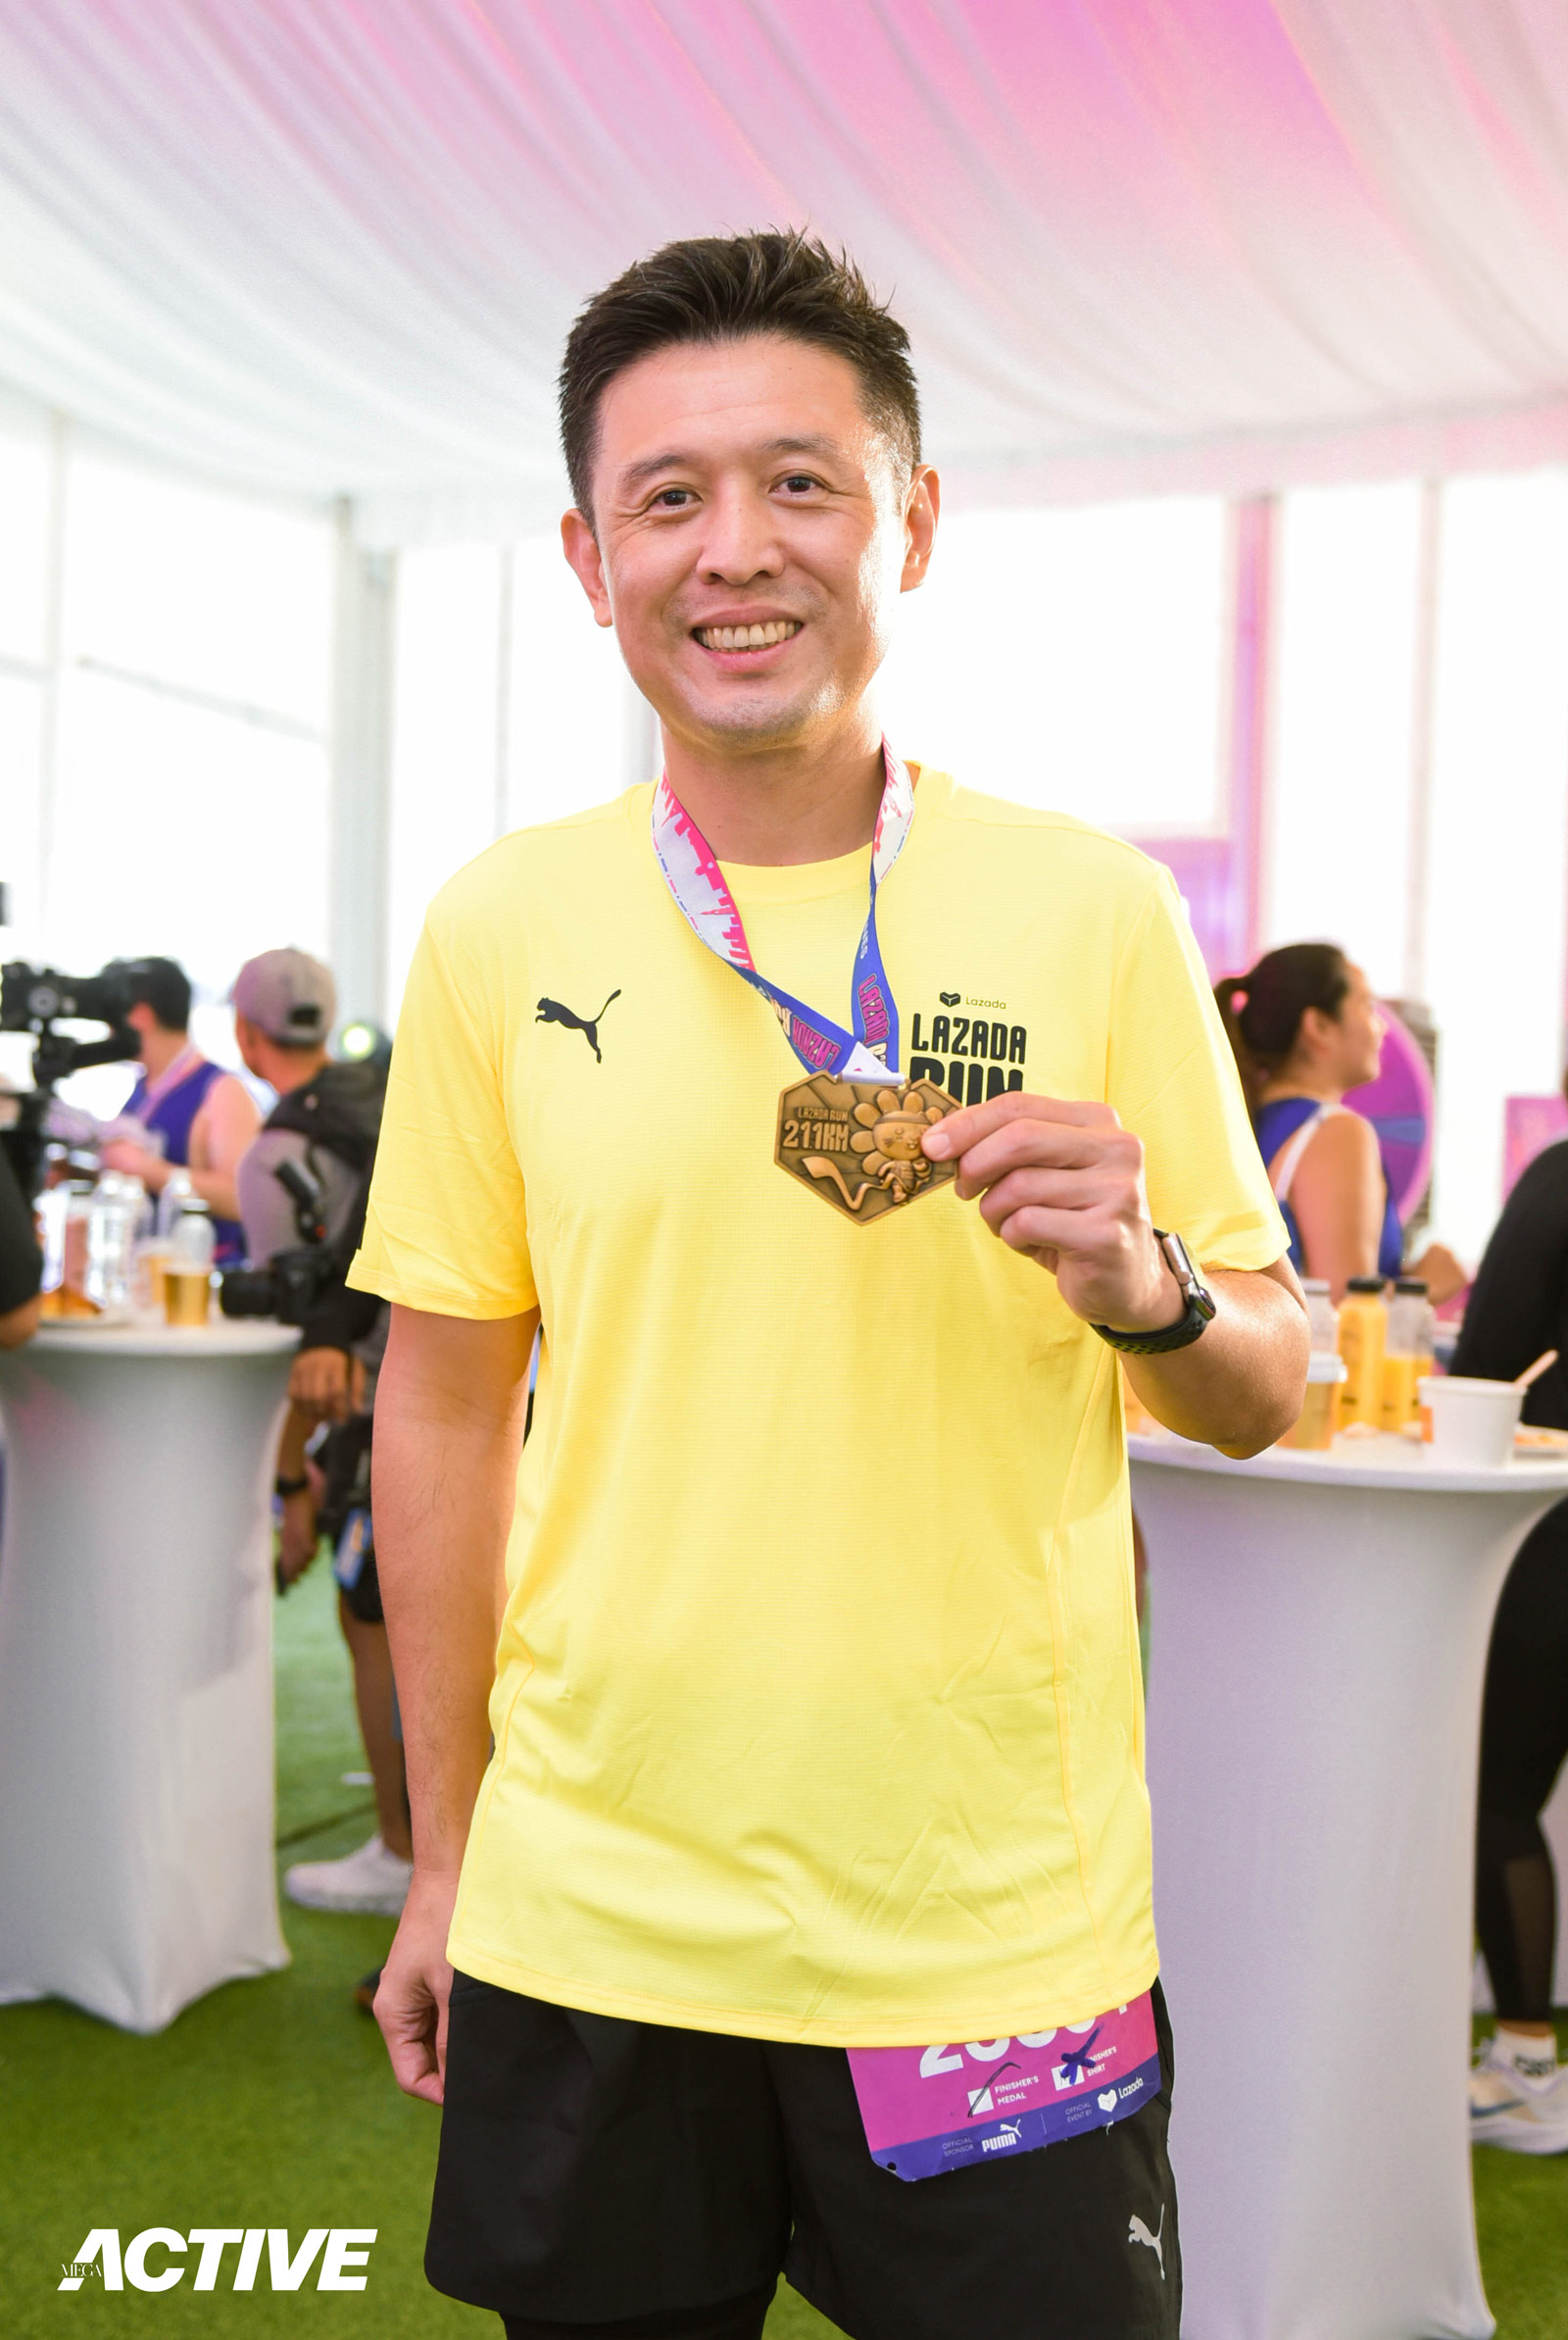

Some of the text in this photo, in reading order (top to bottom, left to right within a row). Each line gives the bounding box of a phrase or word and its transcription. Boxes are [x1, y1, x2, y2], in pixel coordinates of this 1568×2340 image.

[965, 996, 1006, 1010] Lazada
[911, 1013, 1027, 1066] LAZADA
[798, 1107, 849, 1122] LAZADA RUN
[1086, 2063, 1106, 2077] SHIRT
[994, 2075, 1040, 2094] FINISHER'S
[1117, 2076, 1145, 2100] Lazada
[997, 2092, 1027, 2106] MEDAL
[1065, 2102, 1092, 2116] OFFICIAL
[1067, 2109, 1094, 2123] EVENT BY
[942, 2137, 973, 2150] OFFICIAL
[981, 2132, 1017, 2153] PUMA
[944, 2144, 975, 2157] SPONSOR
